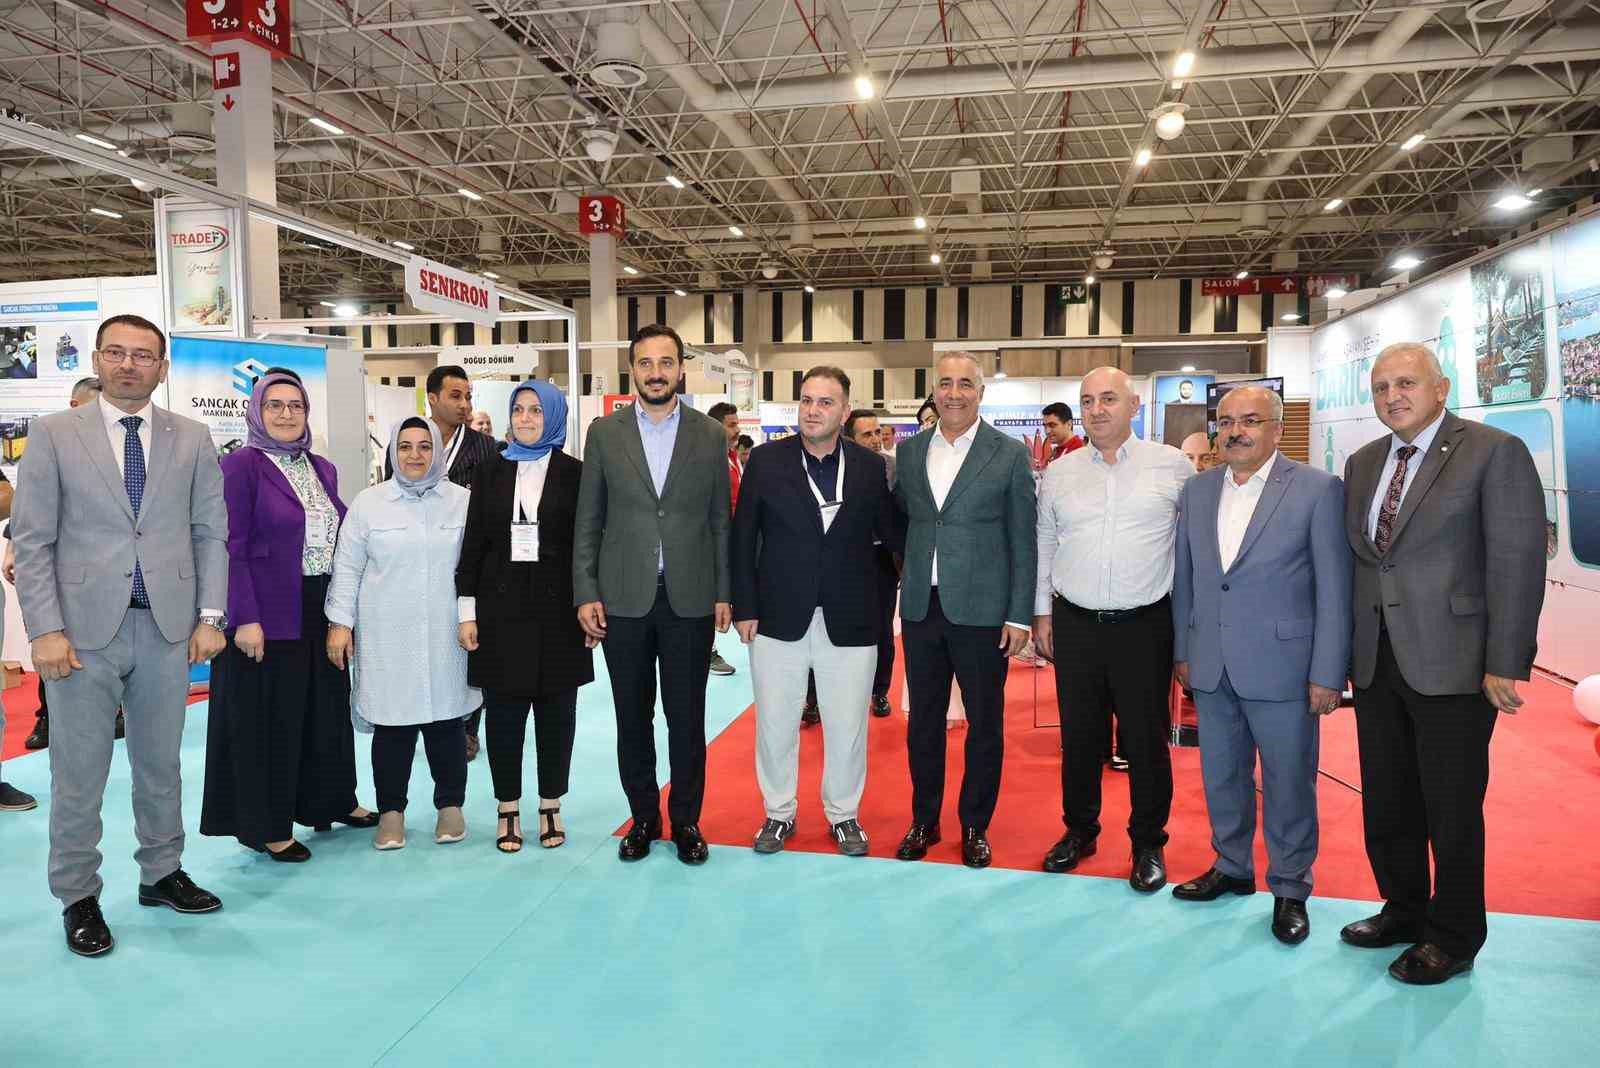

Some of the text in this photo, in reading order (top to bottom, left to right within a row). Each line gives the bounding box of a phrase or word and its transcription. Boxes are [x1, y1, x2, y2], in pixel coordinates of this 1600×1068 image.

[589, 200, 603, 222] 3
[420, 269, 488, 309] SENKRON
[1204, 279, 1260, 292] SALON 1
[192, 397, 238, 409] SANCAK
